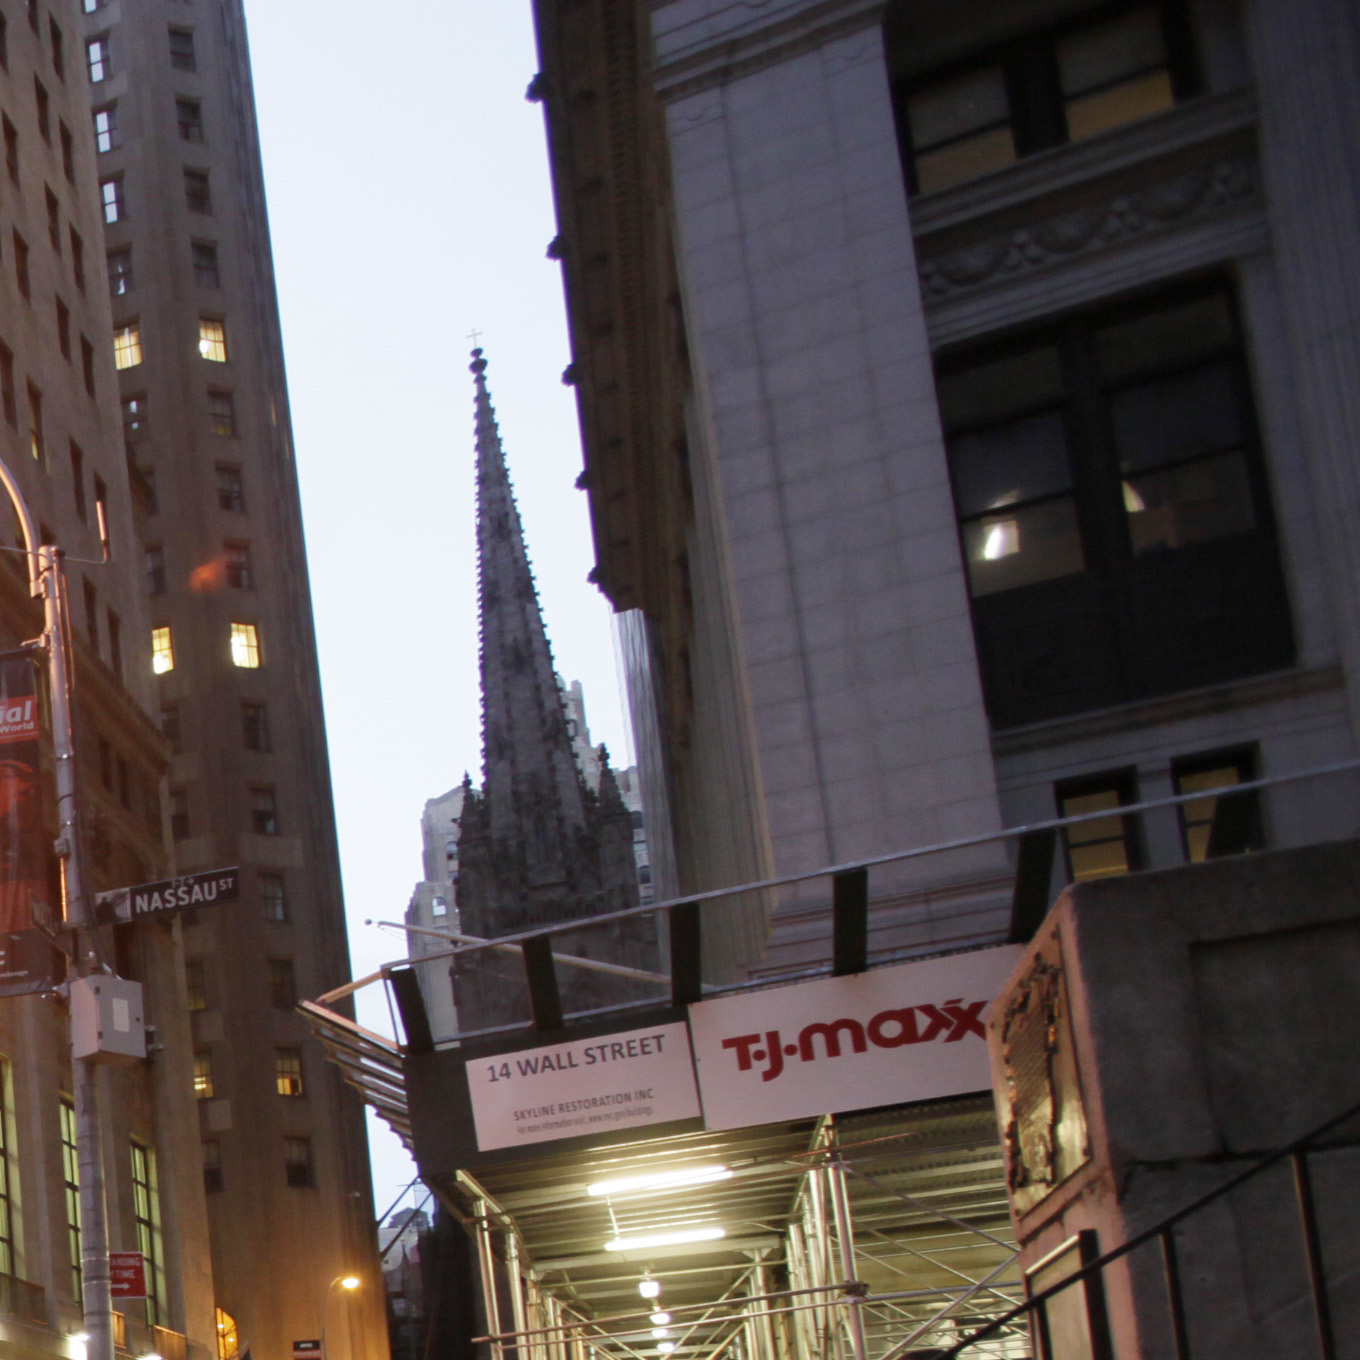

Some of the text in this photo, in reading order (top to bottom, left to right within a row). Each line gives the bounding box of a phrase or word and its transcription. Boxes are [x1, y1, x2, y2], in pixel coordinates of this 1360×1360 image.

[135, 878, 234, 914] NASSAU ST
[487, 1034, 665, 1082] 14 WALL STREET
[514, 1088, 654, 1121] SKYLINE RESTORATION INC
